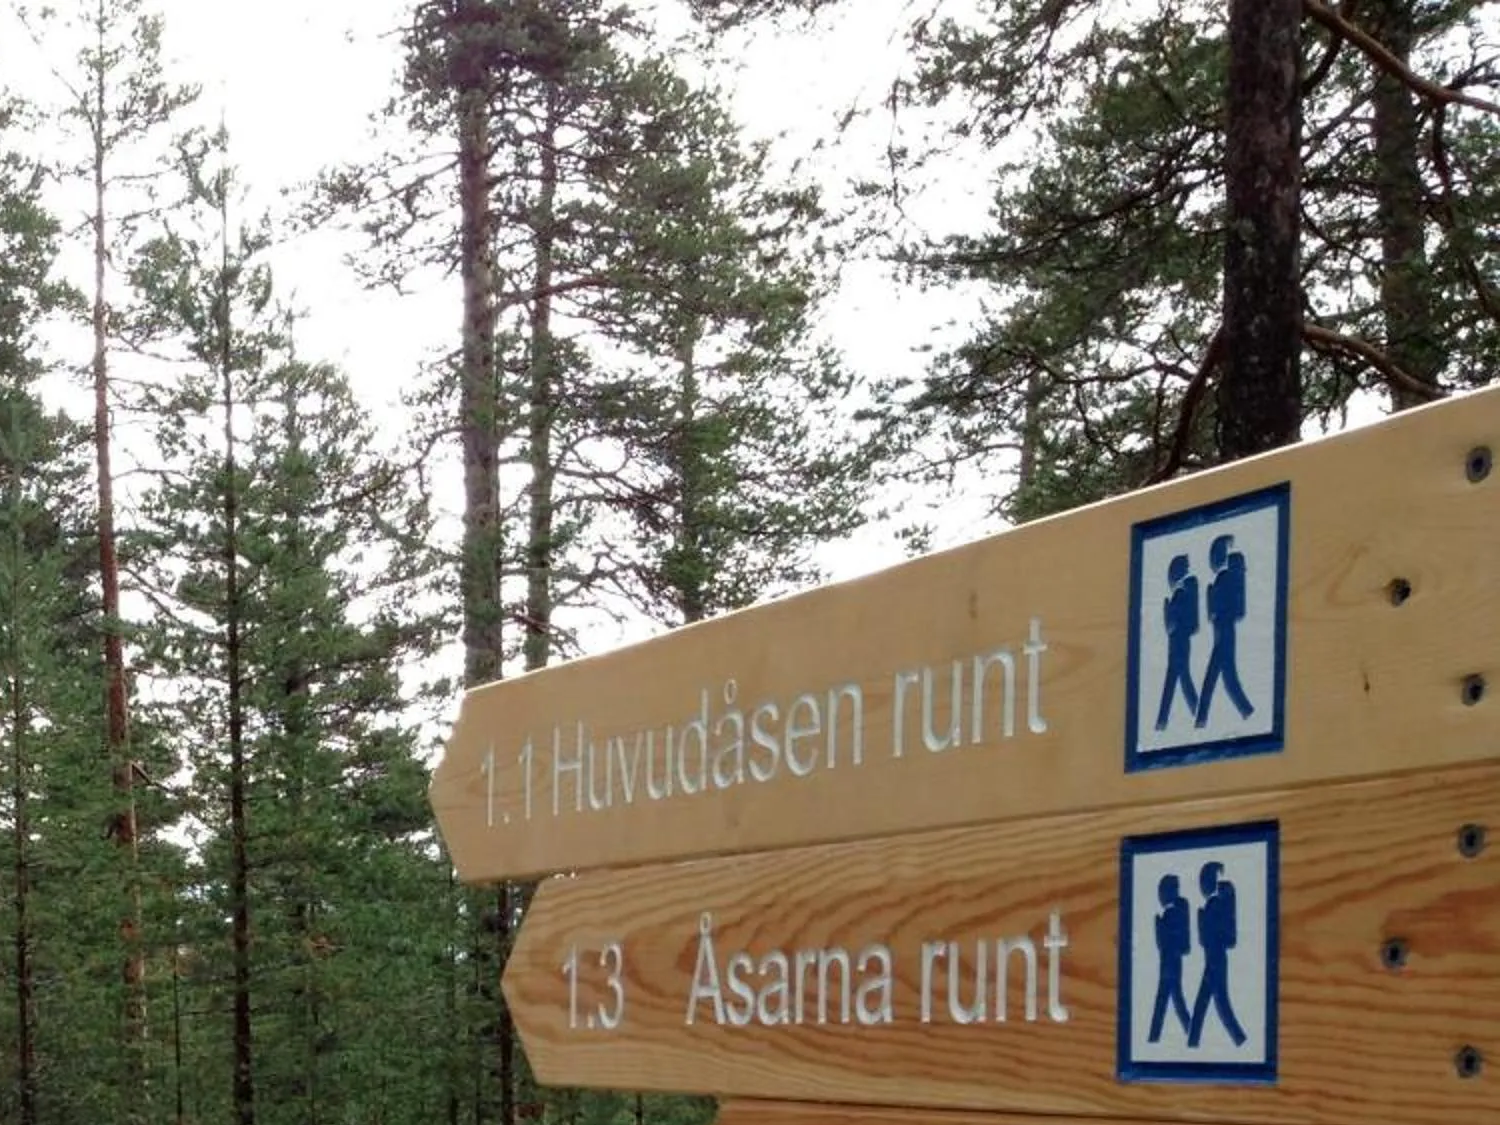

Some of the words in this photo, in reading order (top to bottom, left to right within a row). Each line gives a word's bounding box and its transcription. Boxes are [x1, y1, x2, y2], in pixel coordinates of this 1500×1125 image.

[479, 732, 534, 826] 1.1
[552, 678, 864, 816] Huvudåsen
[892, 616, 1048, 758] runt
[561, 941, 625, 1030] 1.3
[685, 911, 893, 1026] Åsarna
[920, 907, 1069, 1025] runt
